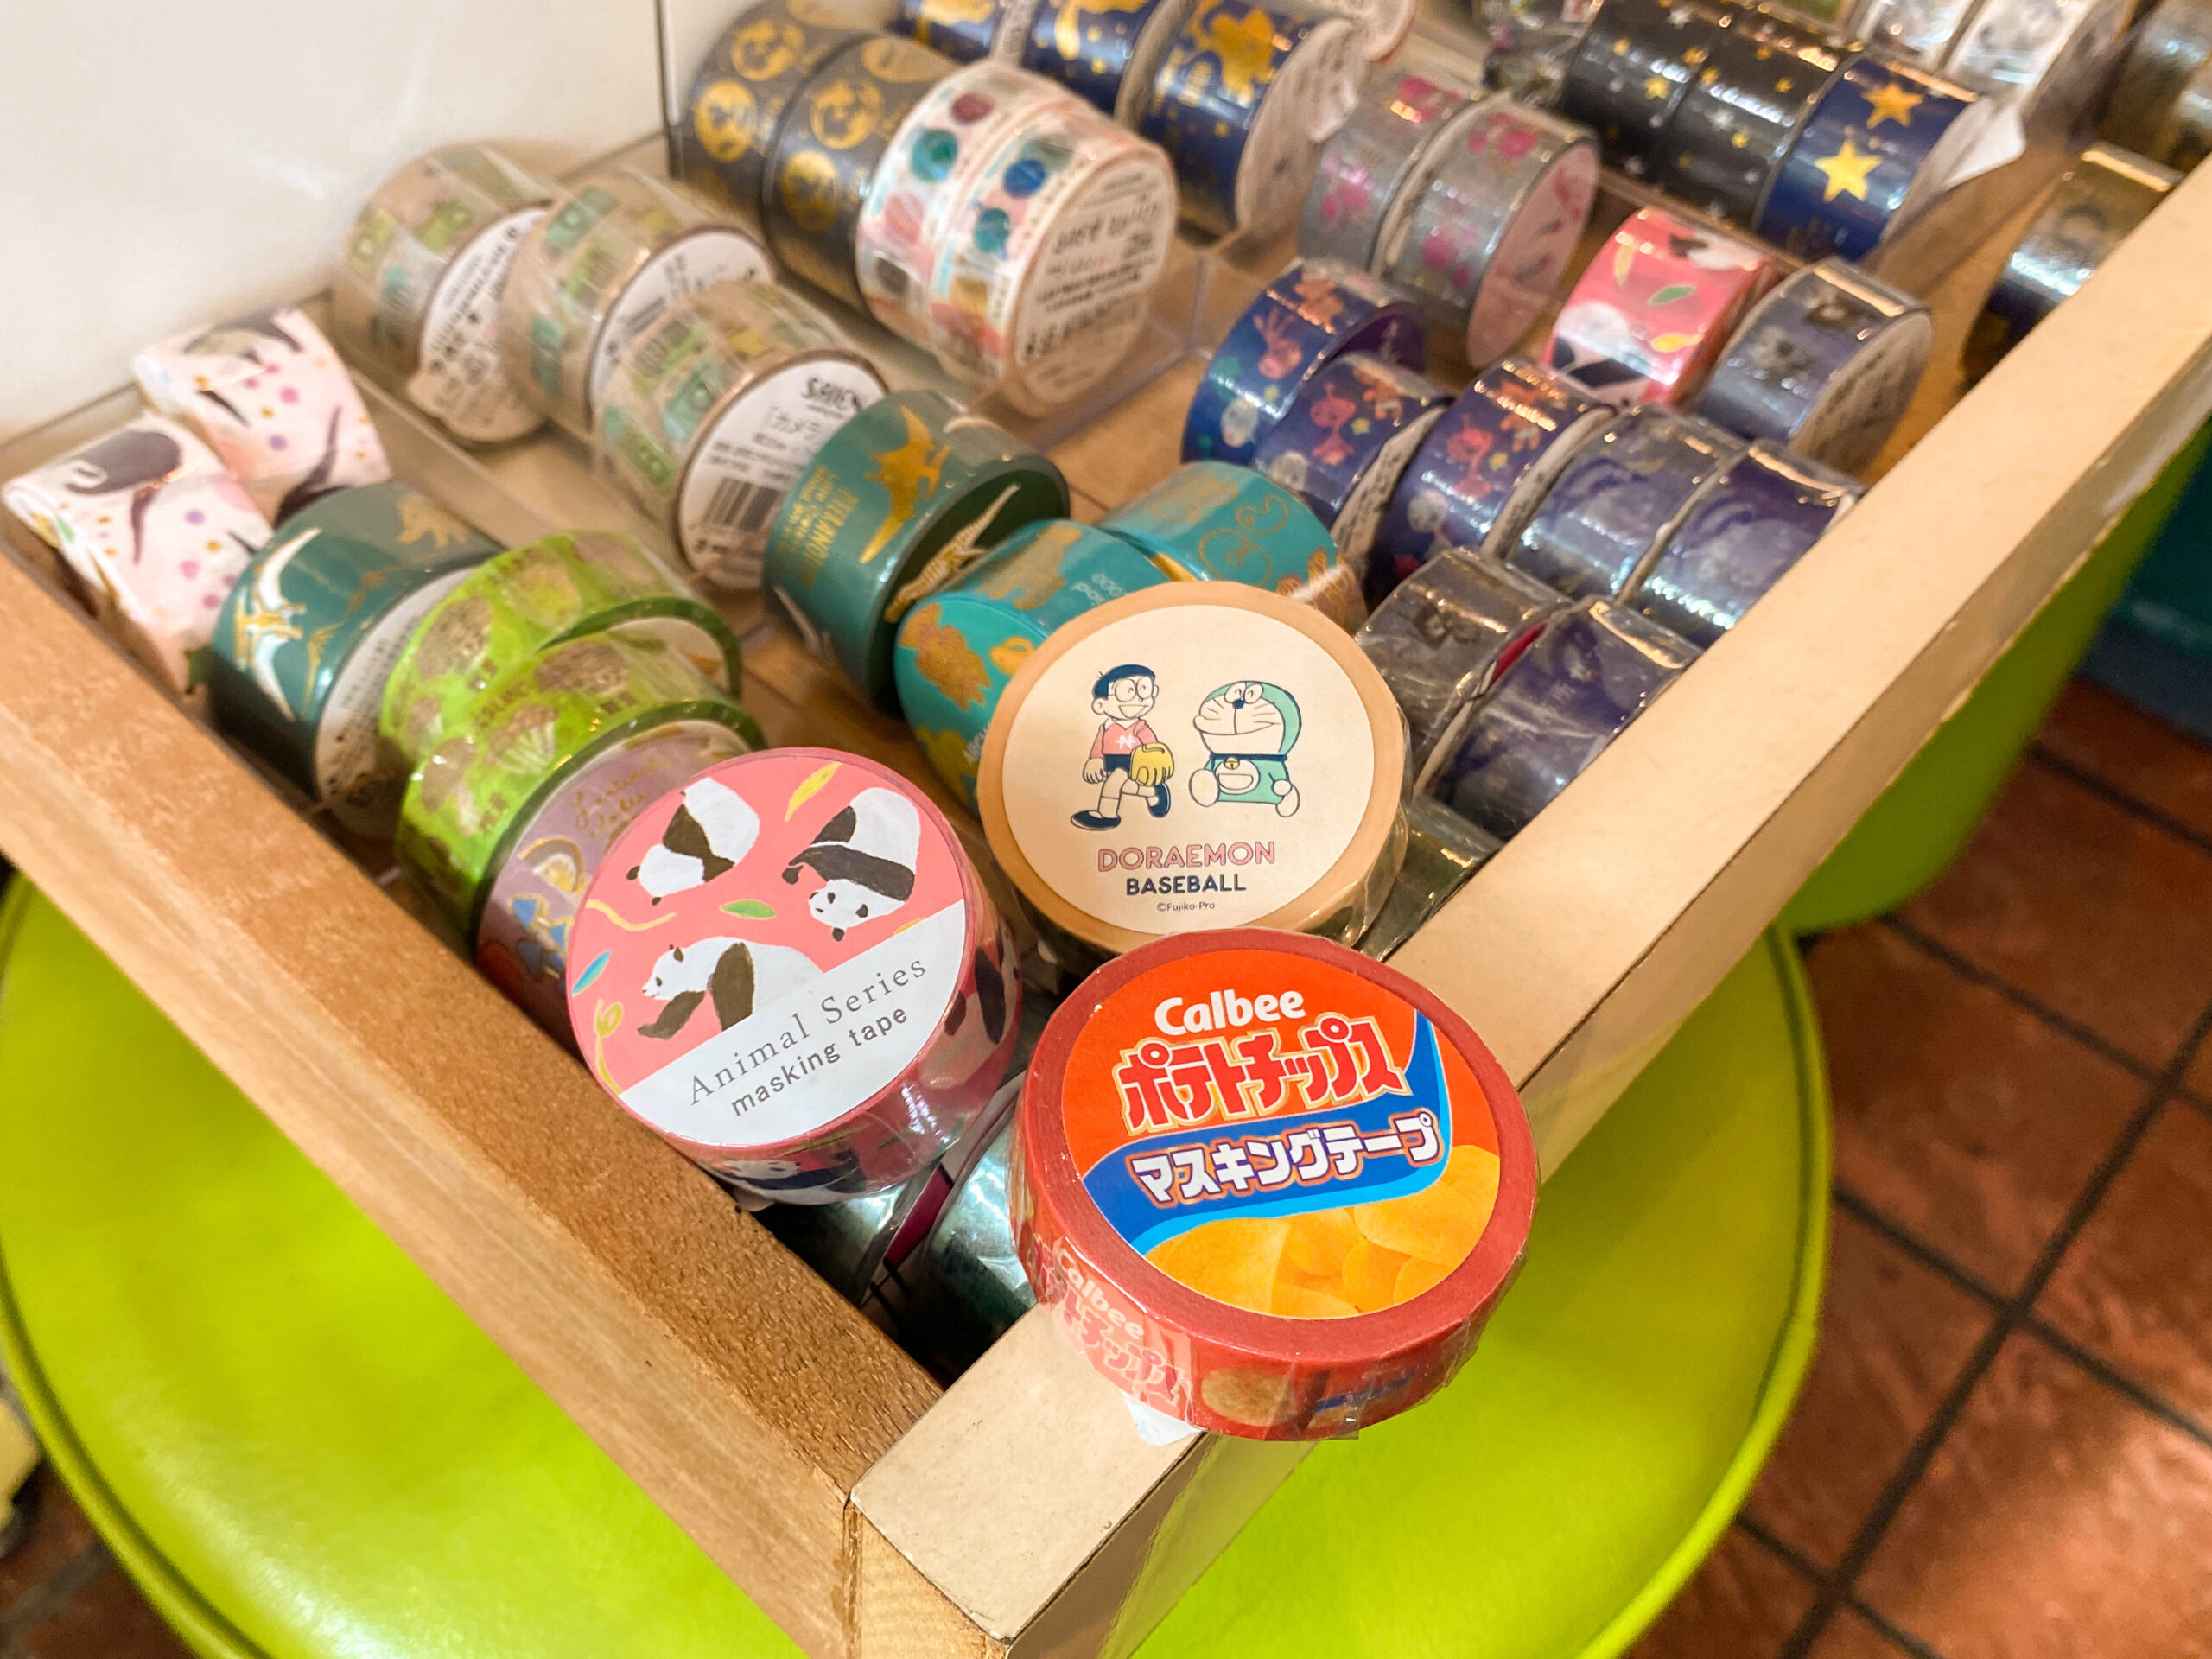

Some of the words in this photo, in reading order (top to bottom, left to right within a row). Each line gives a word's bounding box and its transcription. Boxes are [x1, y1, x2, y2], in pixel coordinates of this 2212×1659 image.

[1097, 841, 1275, 873] DORAEMON
[1126, 874, 1247, 896] BASEBALL
[690, 1013, 810, 1105] Animal
[821, 960, 925, 1024] Series
[1154, 989, 1306, 1036] Calbee
[731, 1042, 841, 1116] masking
[848, 1007, 907, 1046] tape
[1113, 1012, 1413, 1136] ポテトチップス
[1128, 1109, 1443, 1207] マスキングテープ
[1057, 1249, 1145, 1340] Calbee
